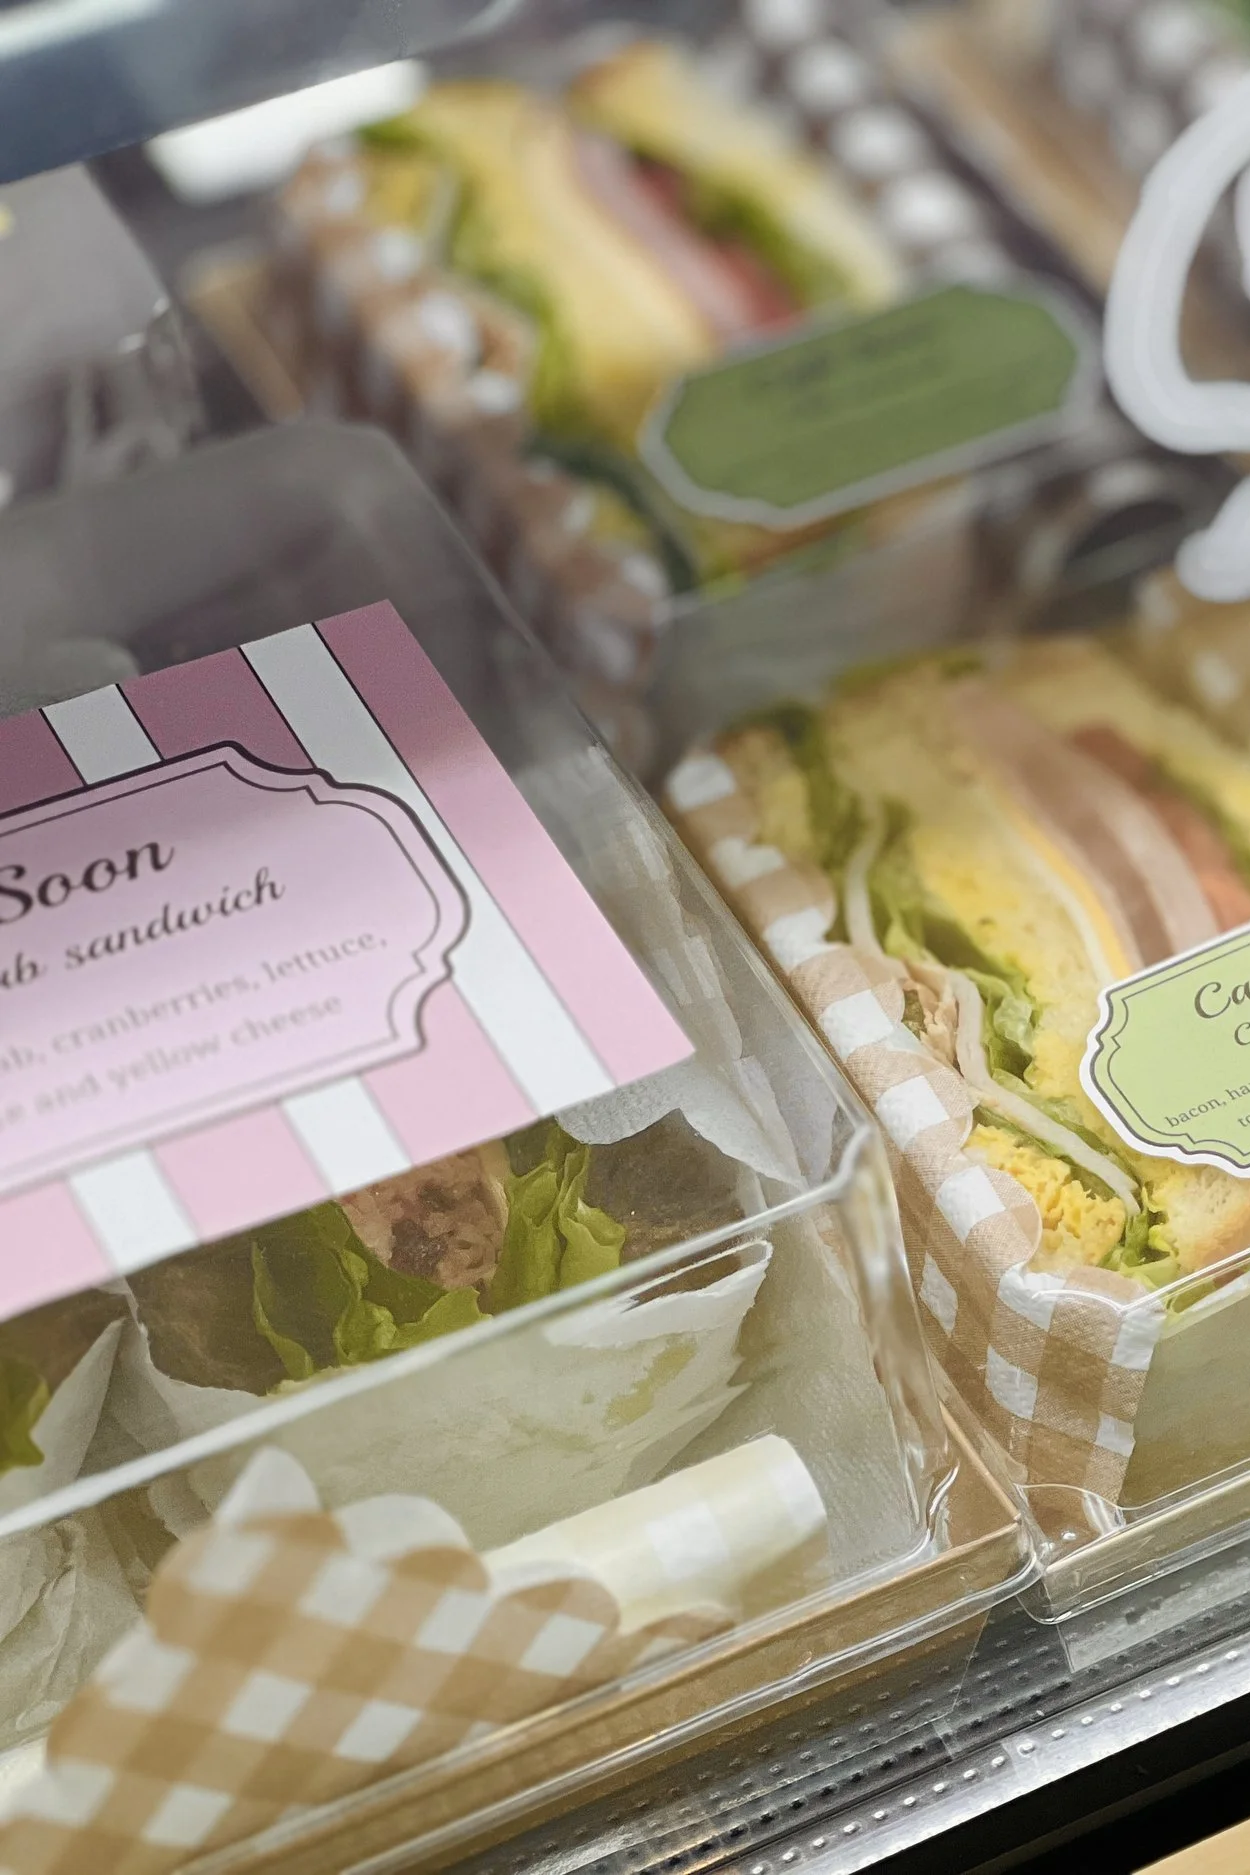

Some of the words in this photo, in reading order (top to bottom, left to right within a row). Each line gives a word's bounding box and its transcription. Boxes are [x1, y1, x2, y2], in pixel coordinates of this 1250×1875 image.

[0, 842, 175, 925] Soon
[65, 866, 286, 971] sandwich
[52, 975, 260, 1054] cranberries,
[261, 933, 388, 984] lettuce,
[106, 1034, 221, 1093] yellow
[230, 997, 343, 1044] cheese
[1165, 1098, 1227, 1128] bacon,
